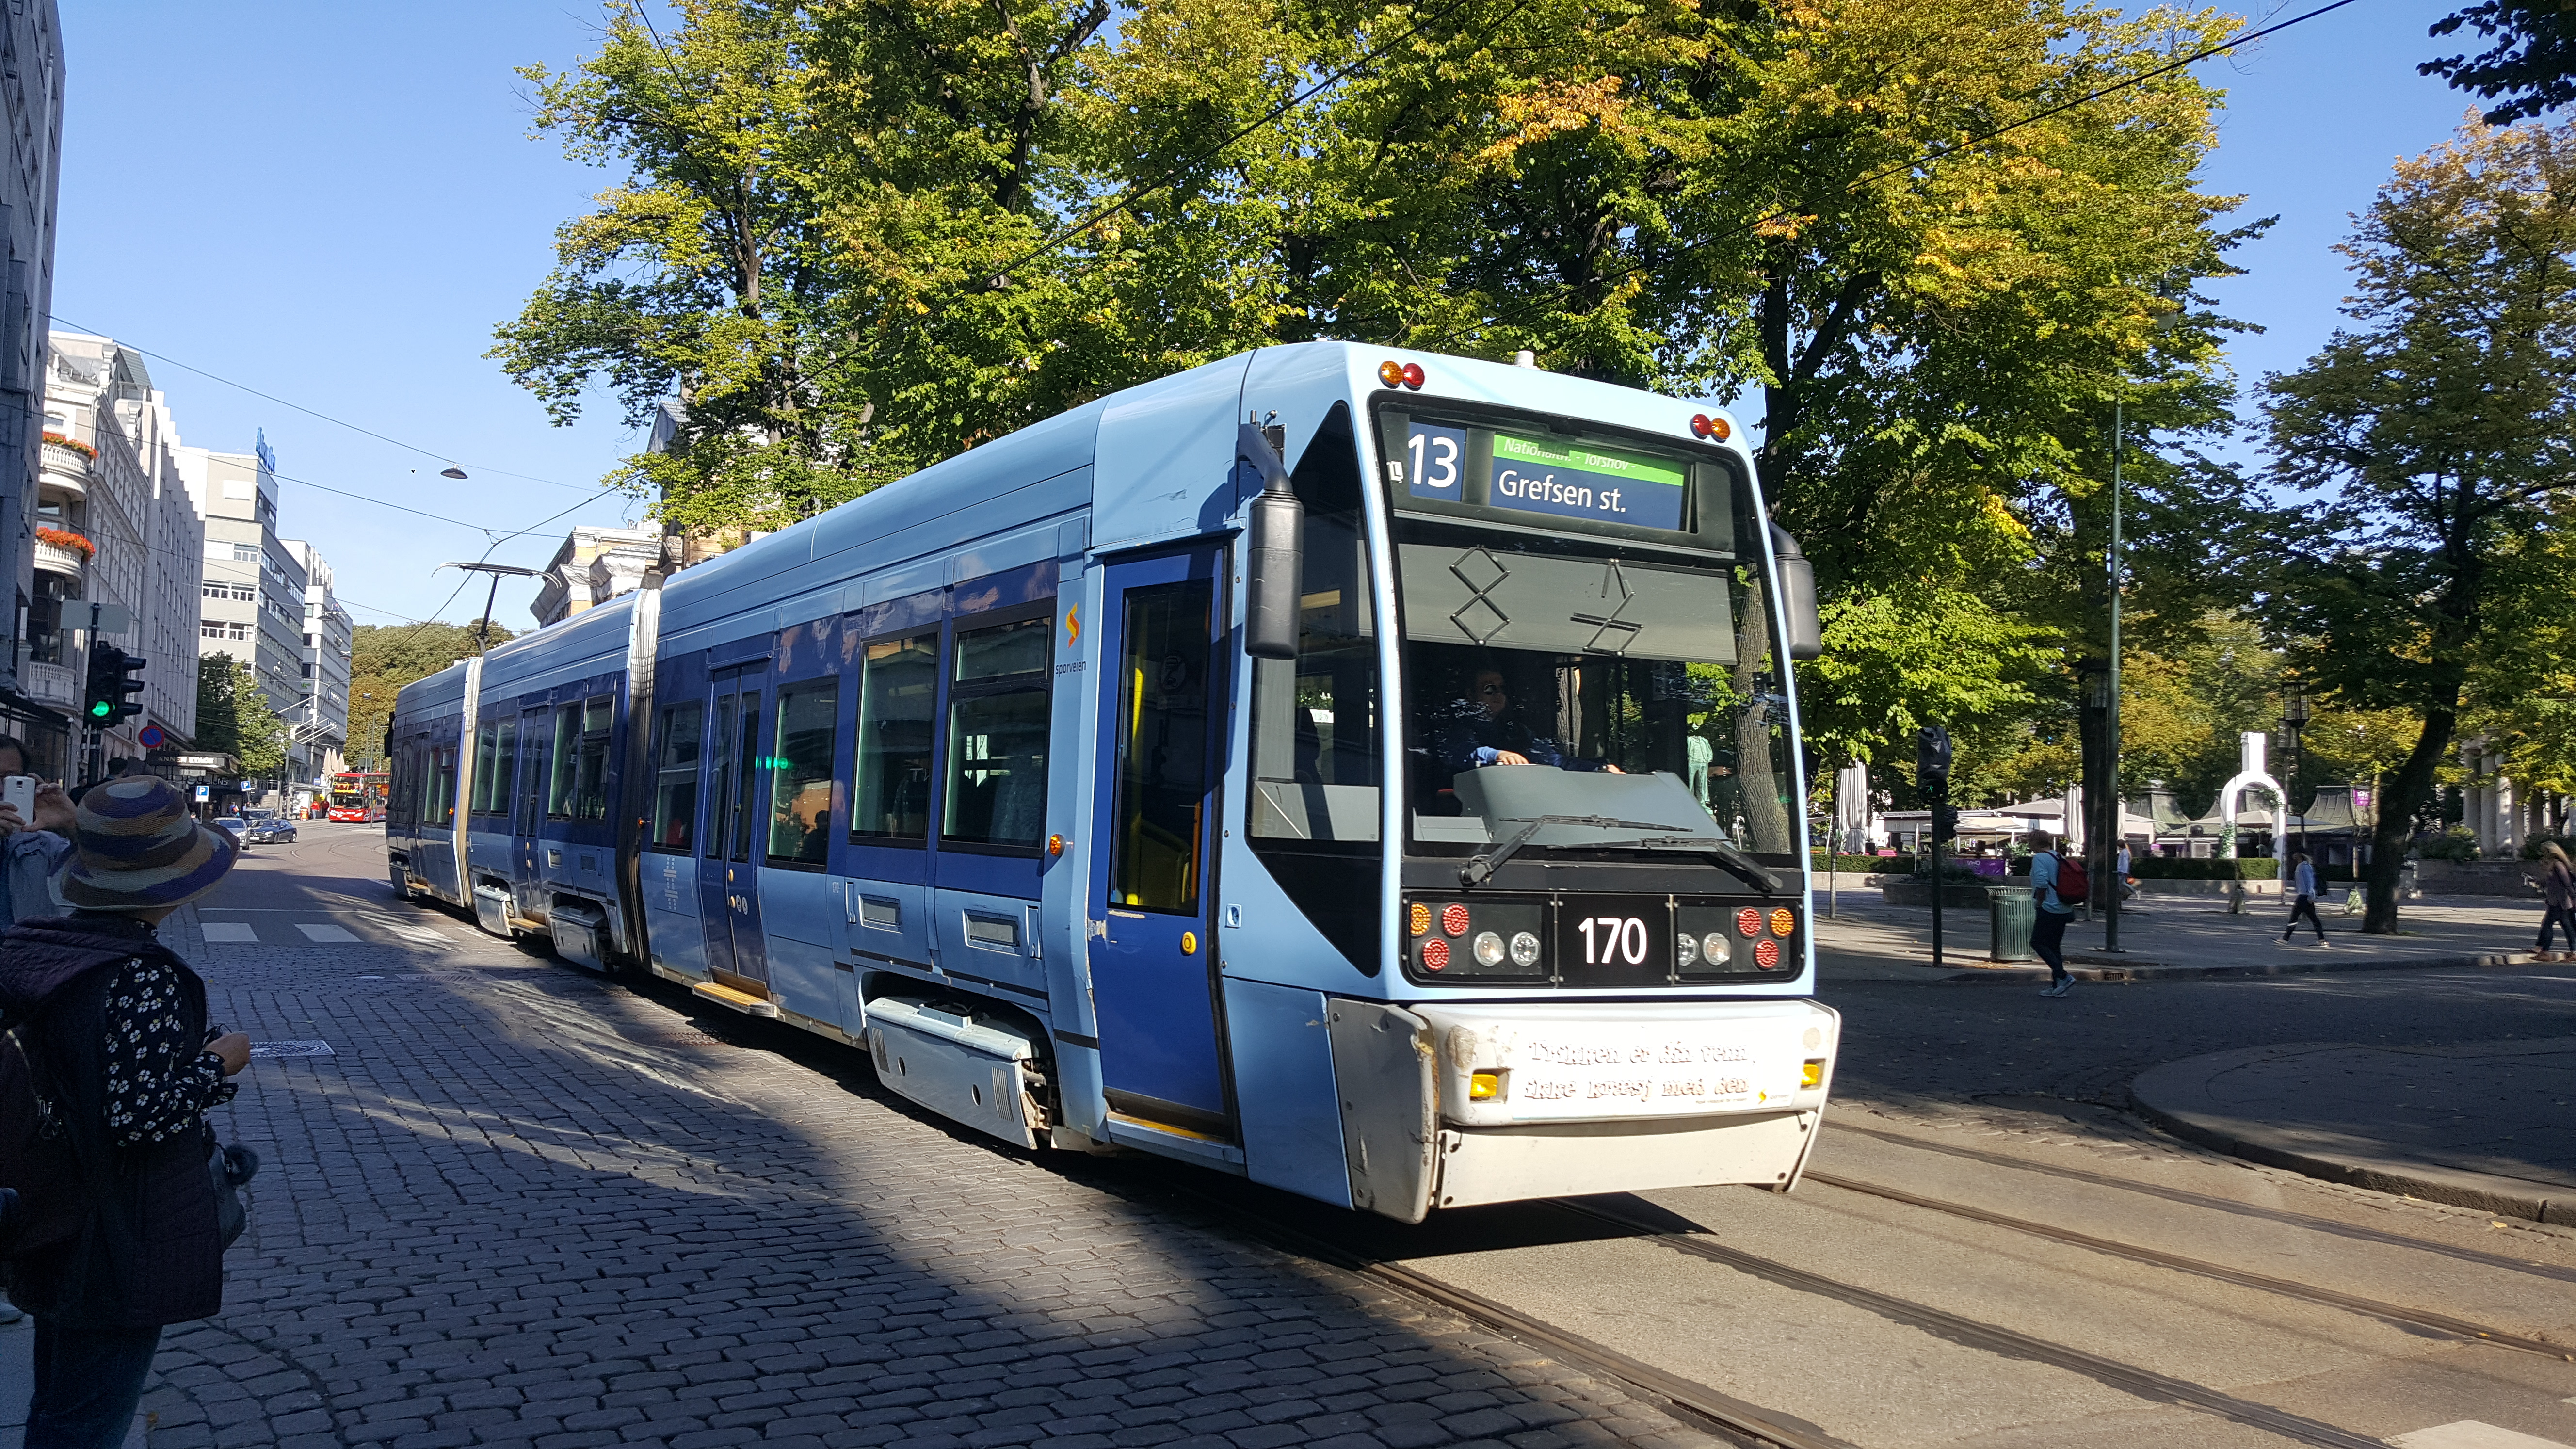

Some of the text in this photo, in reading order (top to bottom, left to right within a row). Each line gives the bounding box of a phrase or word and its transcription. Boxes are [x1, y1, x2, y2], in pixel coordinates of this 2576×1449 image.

[1408, 433, 1459, 488] 13
[1498, 469, 1626, 513] Grefsen st.
[1055, 658, 1086, 678] sporveien
[199, 786, 206, 795] P
[1578, 917, 1647, 965] 170
